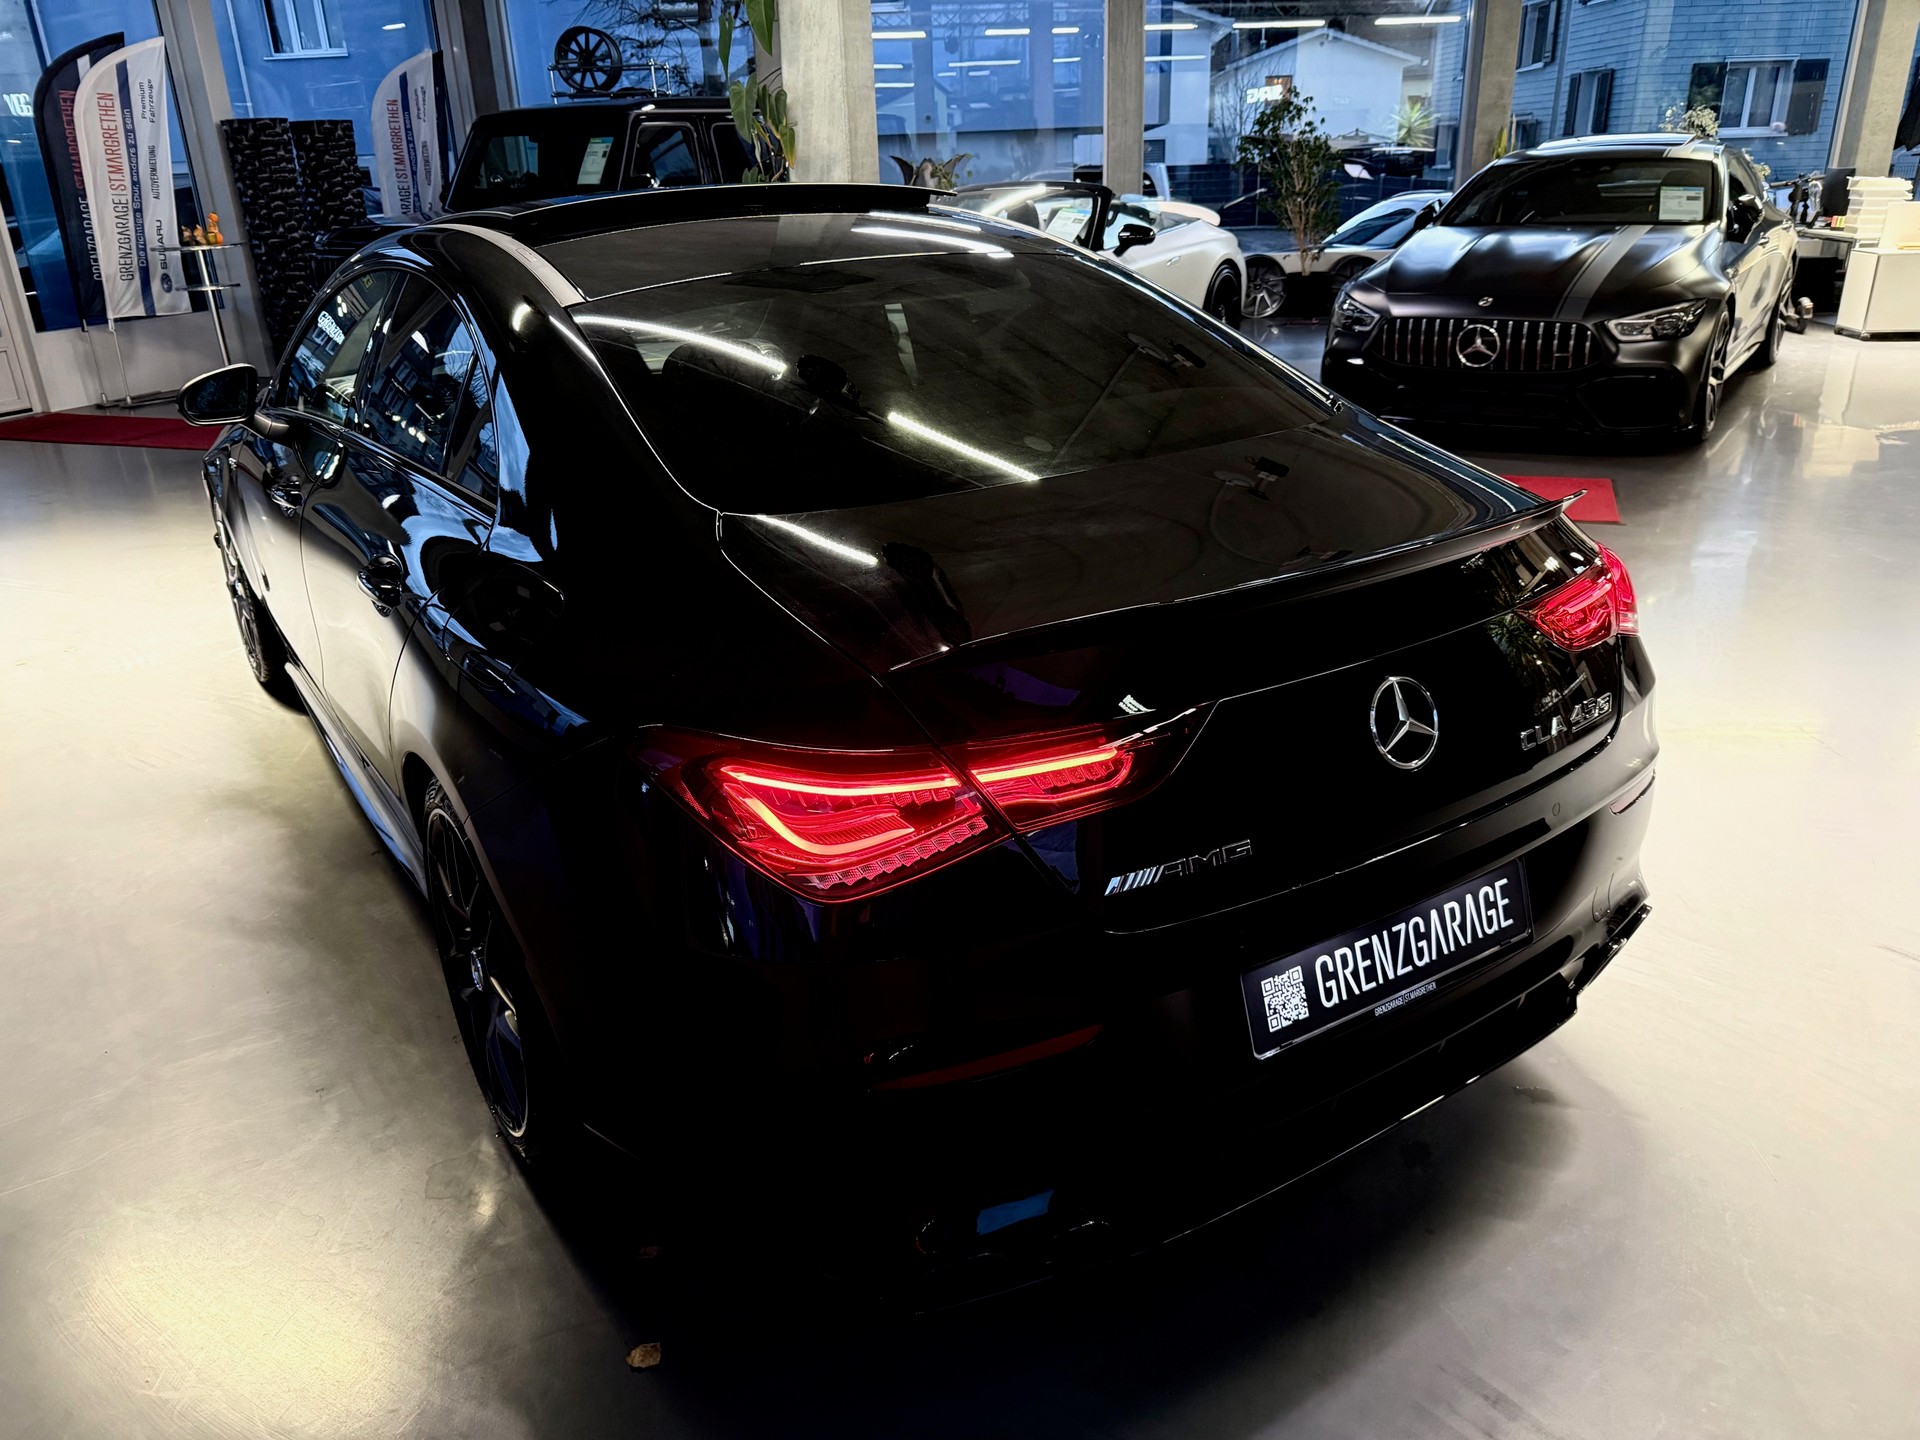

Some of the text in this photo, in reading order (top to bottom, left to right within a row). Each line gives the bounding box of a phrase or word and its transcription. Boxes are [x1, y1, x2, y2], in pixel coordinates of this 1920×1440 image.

[138, 81, 148, 120] Premium
[147, 78, 156, 124] Fahrzeuge
[96, 92, 135, 282] GRENZGARAGE ST.MARGRETHEN
[123, 108, 147, 267] Die richtige Spur, anders zu sein
[147, 144, 162, 200] AUTOVERMIETUNG
[1520, 715, 1567, 751] CLA
[1315, 878, 1514, 1008] GRENZGARAGE
